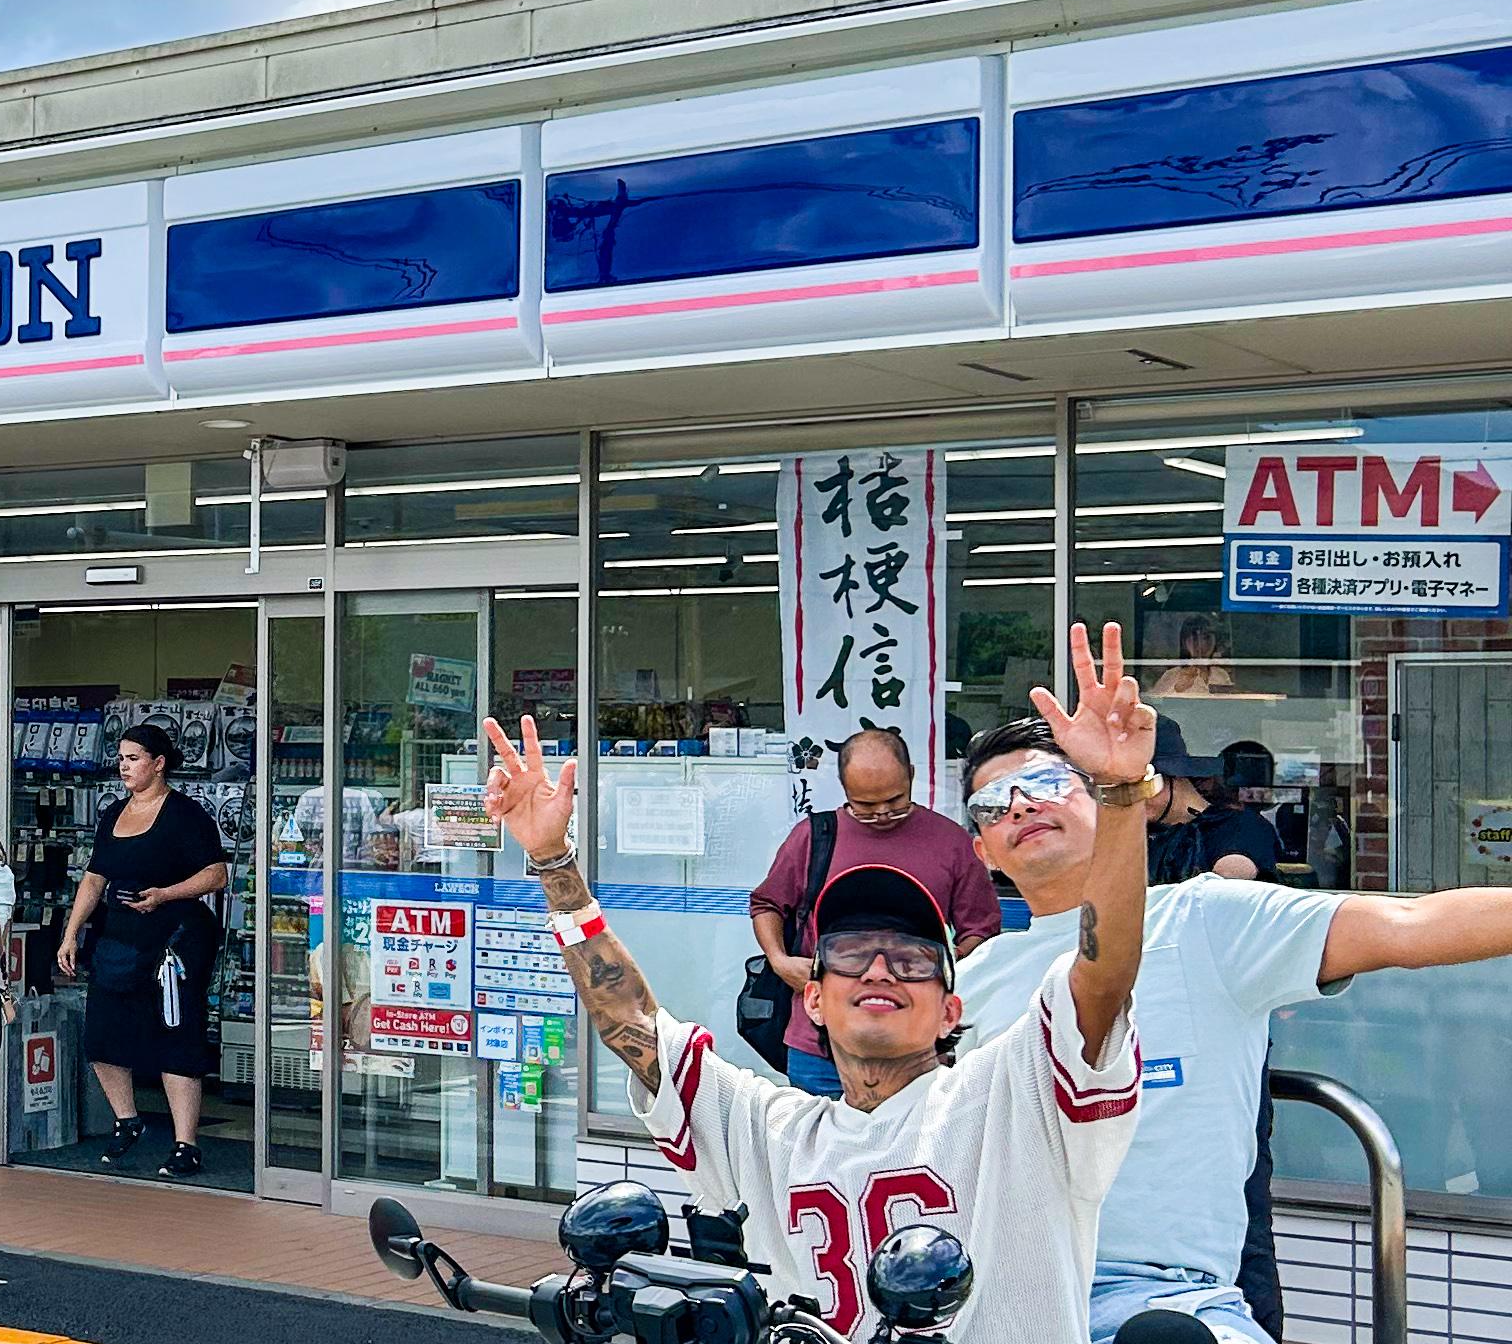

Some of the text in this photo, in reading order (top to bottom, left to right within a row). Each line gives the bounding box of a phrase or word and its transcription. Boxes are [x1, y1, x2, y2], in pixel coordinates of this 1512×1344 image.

[1239, 456, 1441, 527] ATM
[1249, 550, 1461, 568] 現金 お引出し・お預入れ
[1240, 578, 1489, 598] チャージ 各種決済アプリ・電子マネー
[1479, 829, 1510, 841] staff
[434, 882, 479, 894] LAWSON
[391, 909, 451, 935] ATM
[383, 937, 457, 954] 現金チャージ
[386, 1010, 417, 1020] In-Store
[373, 1019, 449, 1033] Get Cash Here!
